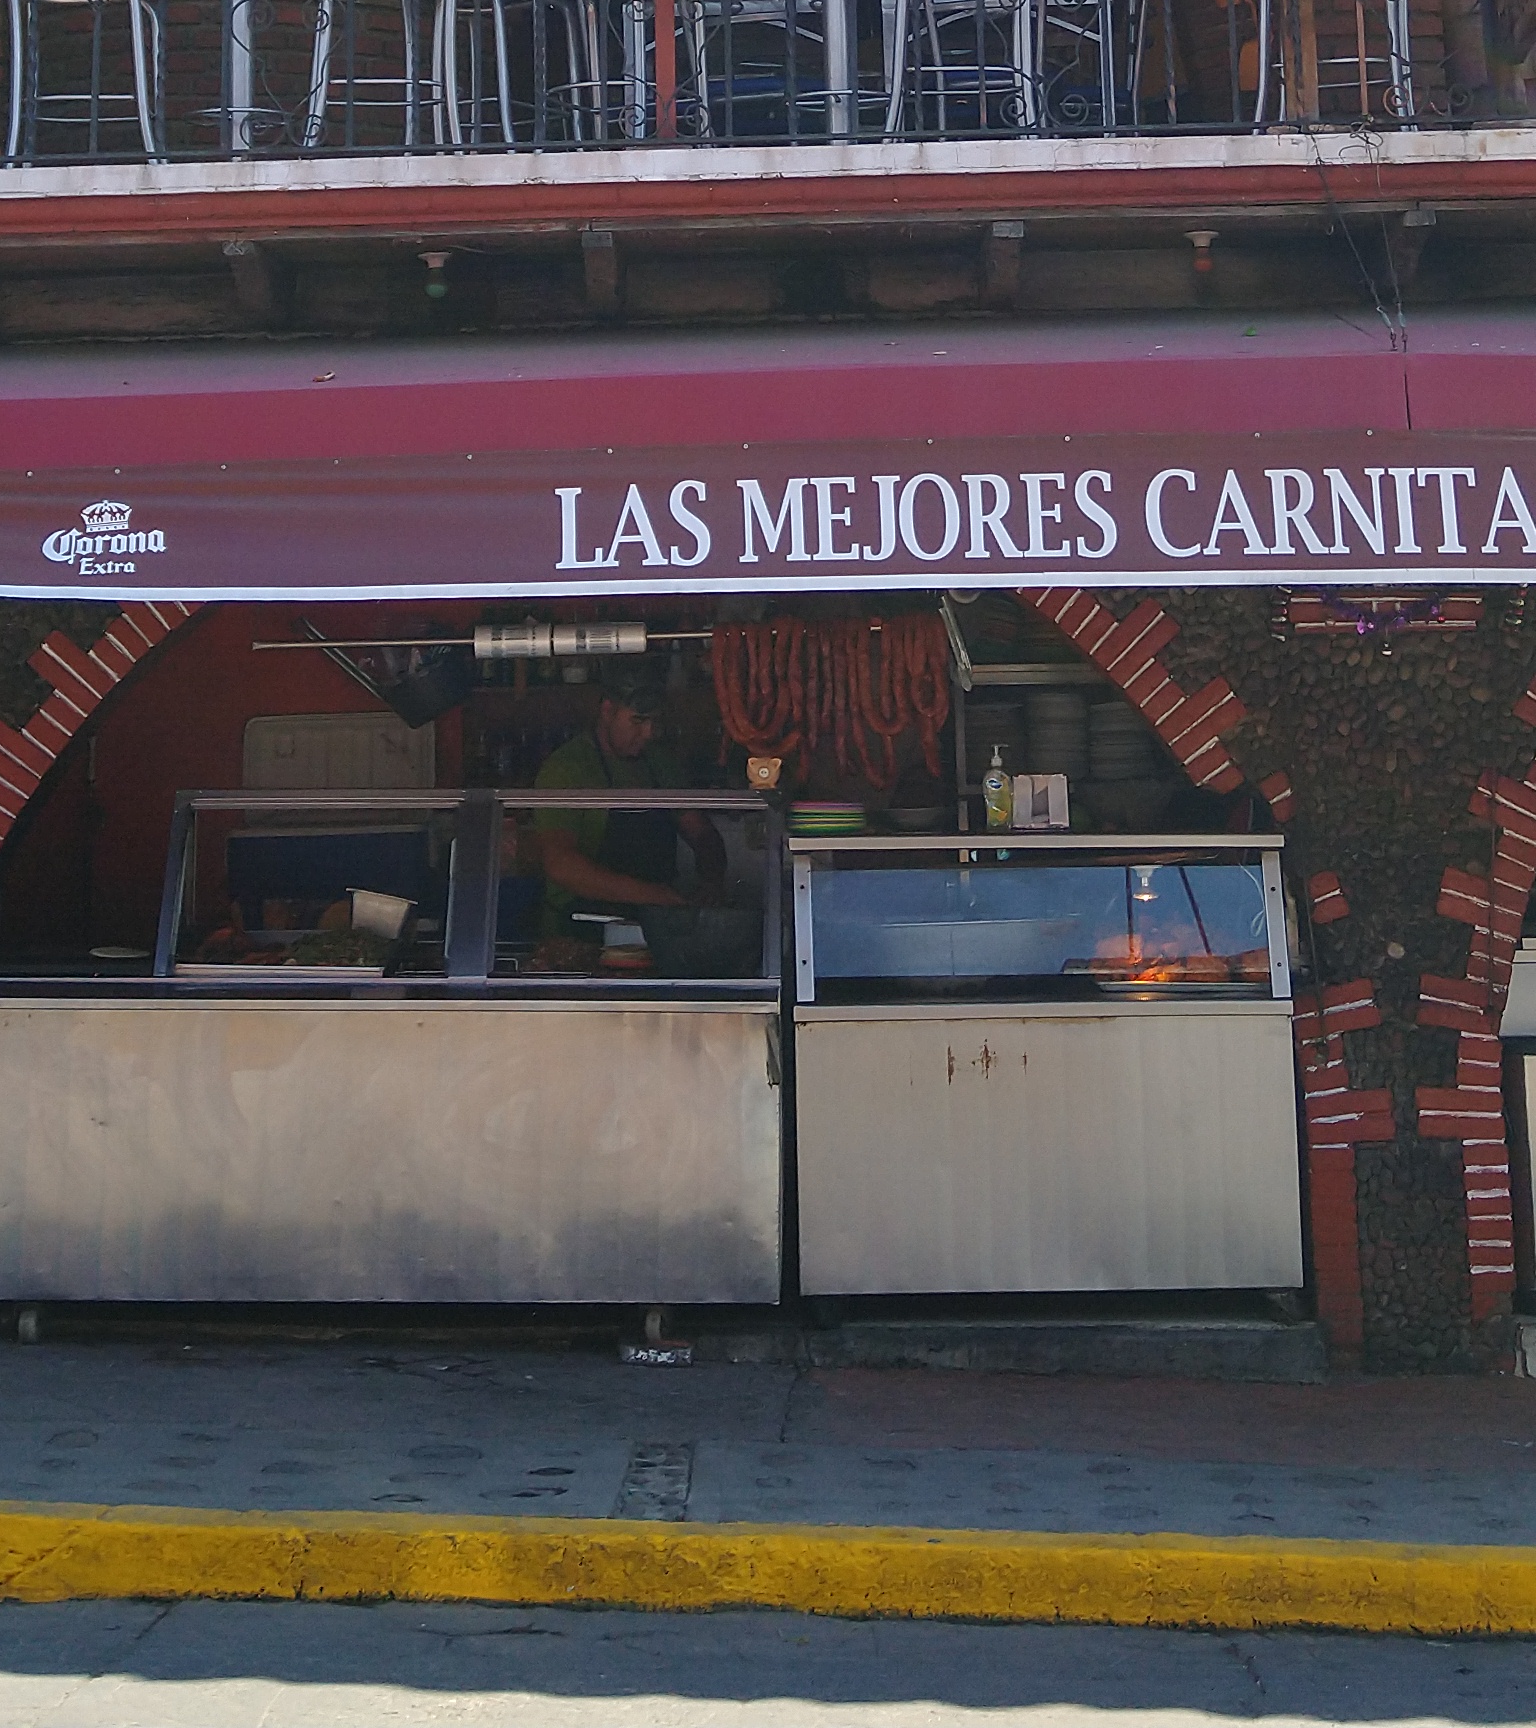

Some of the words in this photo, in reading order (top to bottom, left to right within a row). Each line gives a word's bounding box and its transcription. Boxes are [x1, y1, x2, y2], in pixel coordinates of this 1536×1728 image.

[555, 479, 711, 570] LAS
[737, 471, 1117, 565] MEJORES
[41, 527, 166, 566] Corona
[79, 557, 135, 576] Extra
